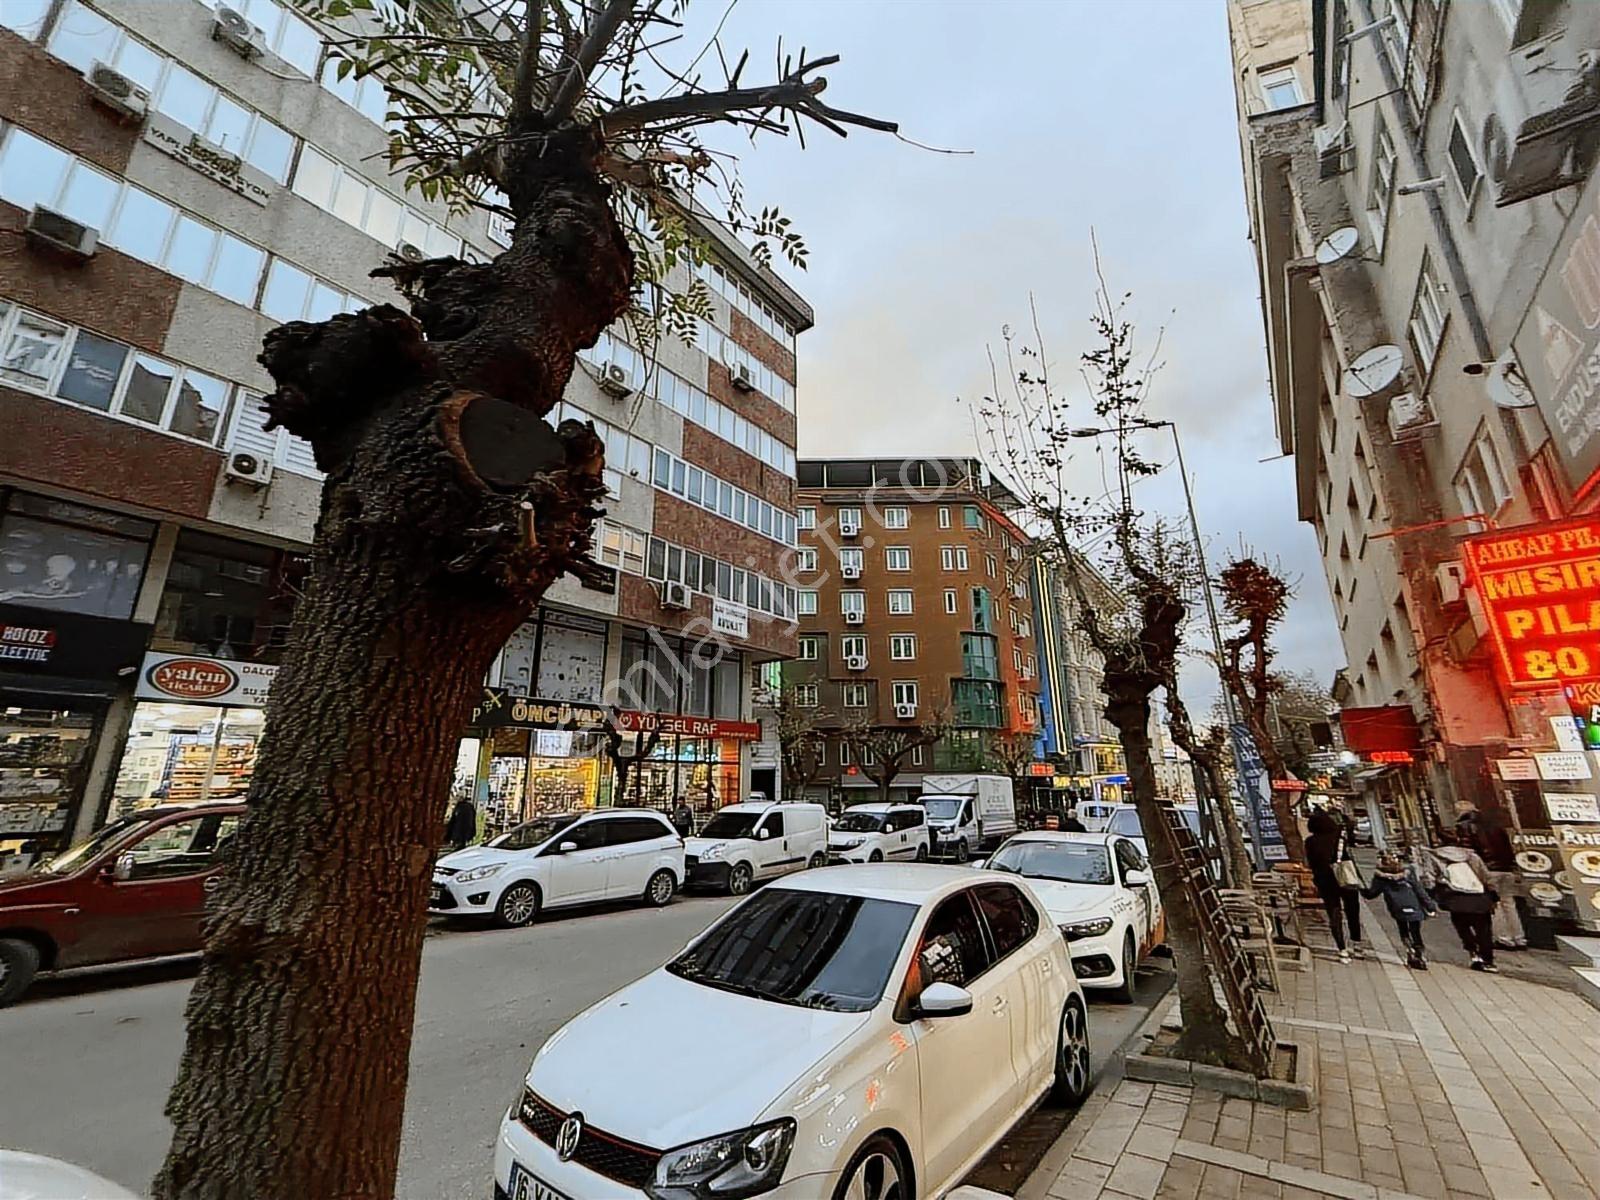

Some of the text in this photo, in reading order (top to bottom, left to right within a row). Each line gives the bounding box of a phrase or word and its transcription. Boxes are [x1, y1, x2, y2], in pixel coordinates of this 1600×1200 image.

[1478, 534, 1555, 565] AHBAP
[243, 666, 278, 677] DALG
[1524, 647, 1590, 679] 80
[162, 667, 226, 685] yalçın
[512, 698, 571, 724] ÖNCÜ
[637, 712, 718, 735] YÜSEL RAF
